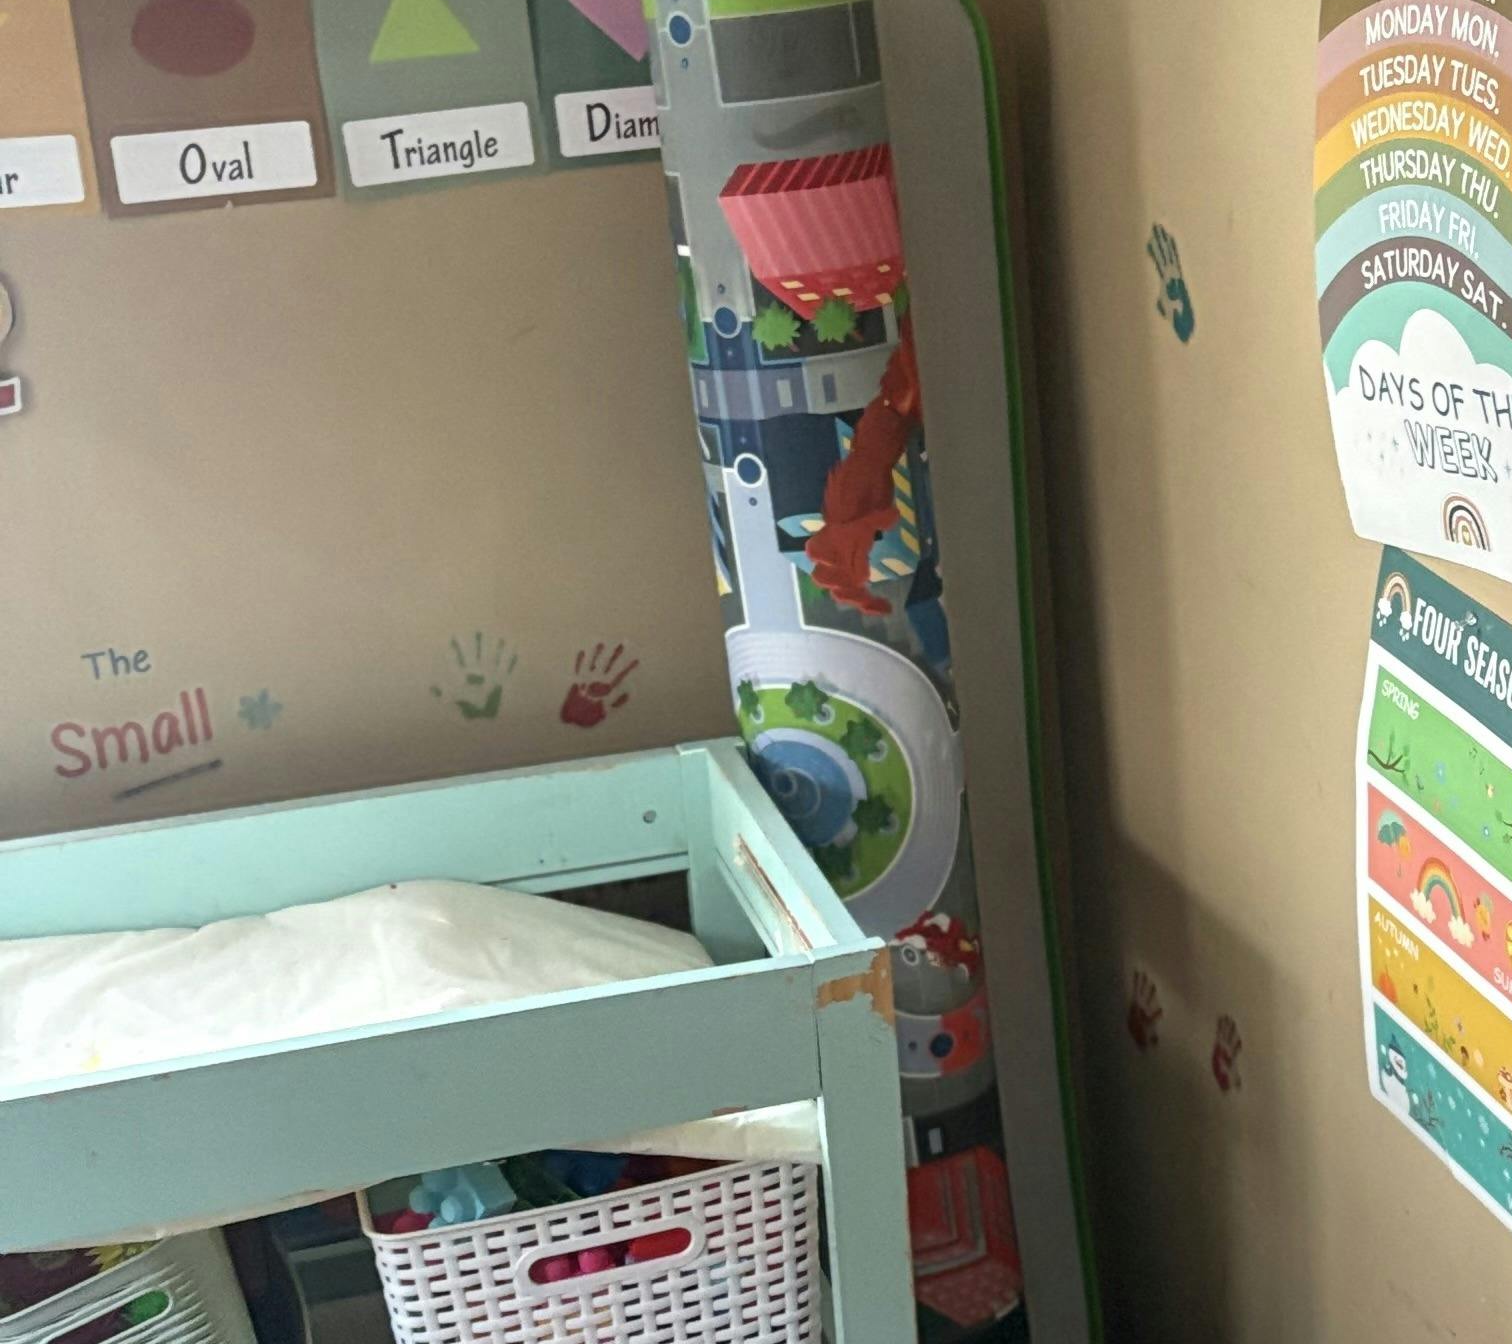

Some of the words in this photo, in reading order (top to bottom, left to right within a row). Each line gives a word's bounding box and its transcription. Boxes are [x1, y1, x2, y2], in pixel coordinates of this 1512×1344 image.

[1365, 4, 1448, 47] MONDAY
[1451, 9, 1499, 57] MON.
[1359, 54, 1446, 96] TUESDAY
[1450, 59, 1499, 114] TUES.
[179, 141, 255, 186] Oval
[380, 128, 499, 170] Triangle
[1351, 100, 1465, 149] WEDNESDAY
[1469, 115, 1511, 178] WED.
[1360, 148, 1456, 189] THURSDAY
[1460, 163, 1499, 219] THU.
[1379, 199, 1445, 234] FRIDAY
[1448, 207, 1479, 260] FRI.
[1361, 247, 1459, 291] SATURDAY
[1461, 270, 1508, 329] SAT.
[1358, 364, 1424, 411] DAYS
[1432, 382, 1464, 419] OF
[1403, 419, 1498, 483] WEEK
[1413, 597, 1462, 666] FOUR
[82, 646, 151, 681] The
[1381, 678, 1420, 721] SPRING
[50, 687, 213, 779] Small
[1374, 911, 1419, 961] AUTUMN
